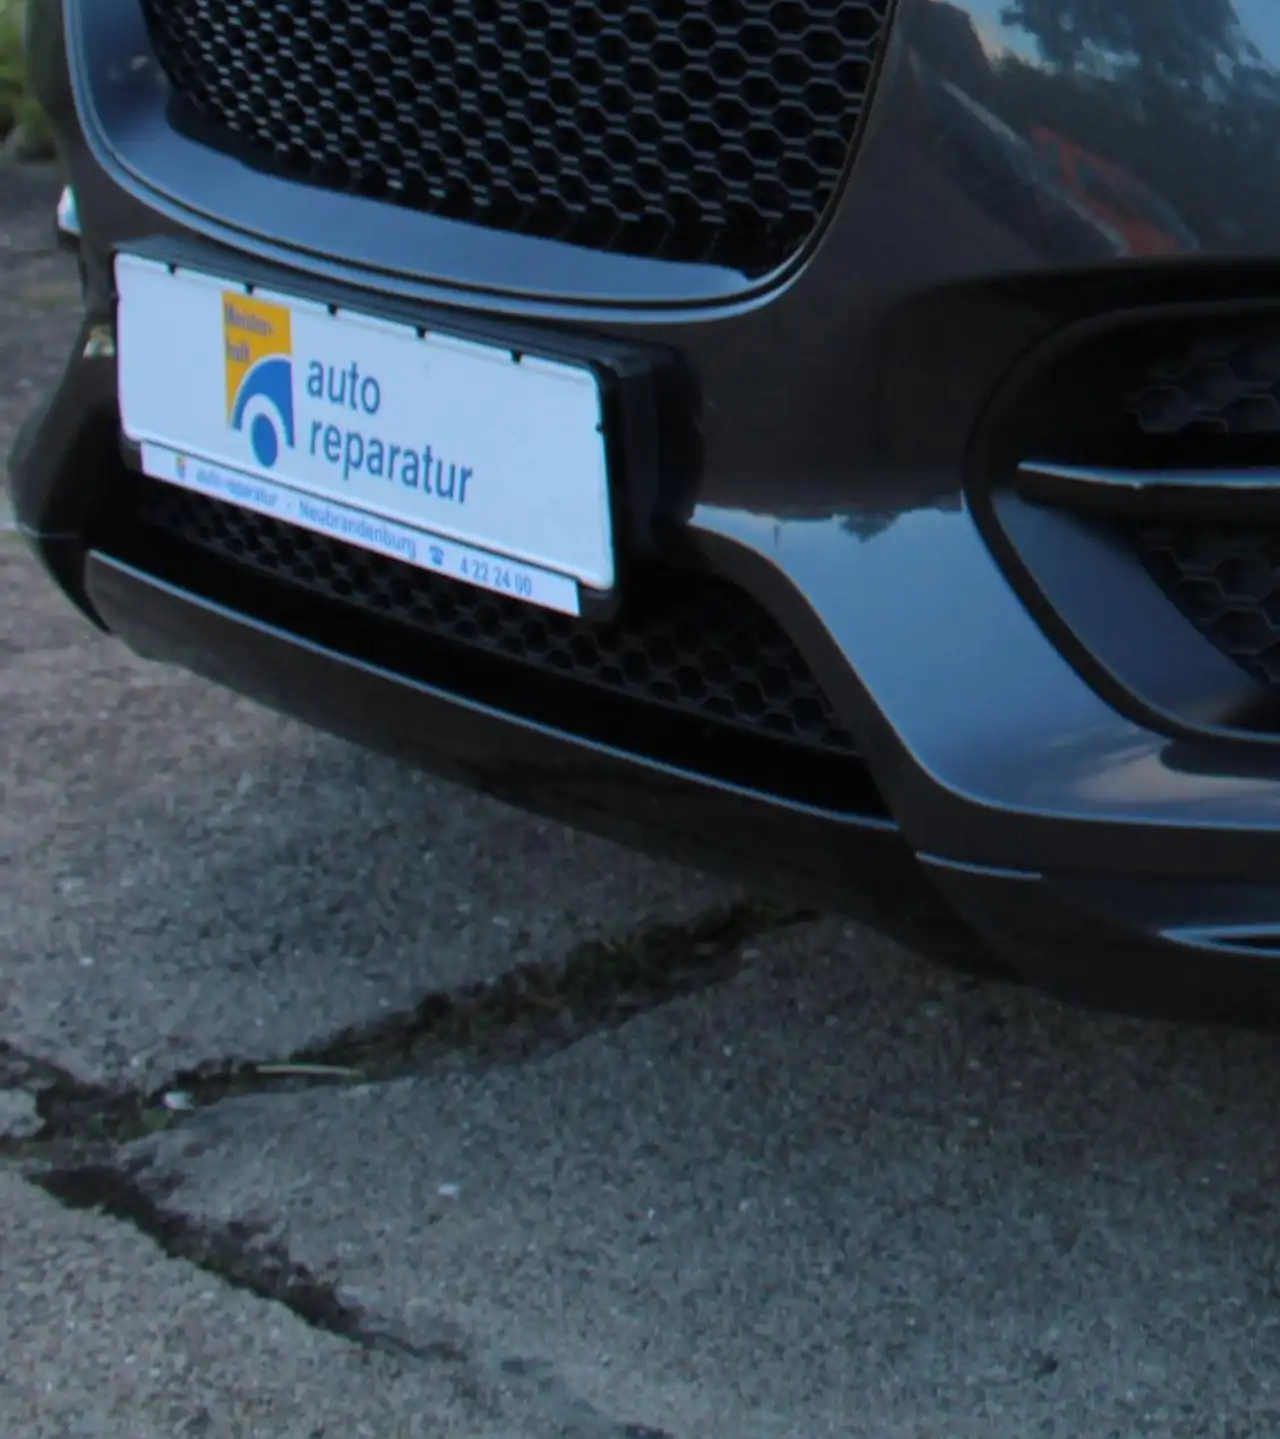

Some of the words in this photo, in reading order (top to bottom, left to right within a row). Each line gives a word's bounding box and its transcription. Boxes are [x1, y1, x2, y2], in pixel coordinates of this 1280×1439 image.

[307, 360, 382, 416] auto
[310, 418, 473, 505] reparatur
[299, 499, 416, 561] Neubrandenburg
[472, 559, 489, 582] 22
[494, 565, 511, 590] 24
[515, 573, 533, 597] 00
